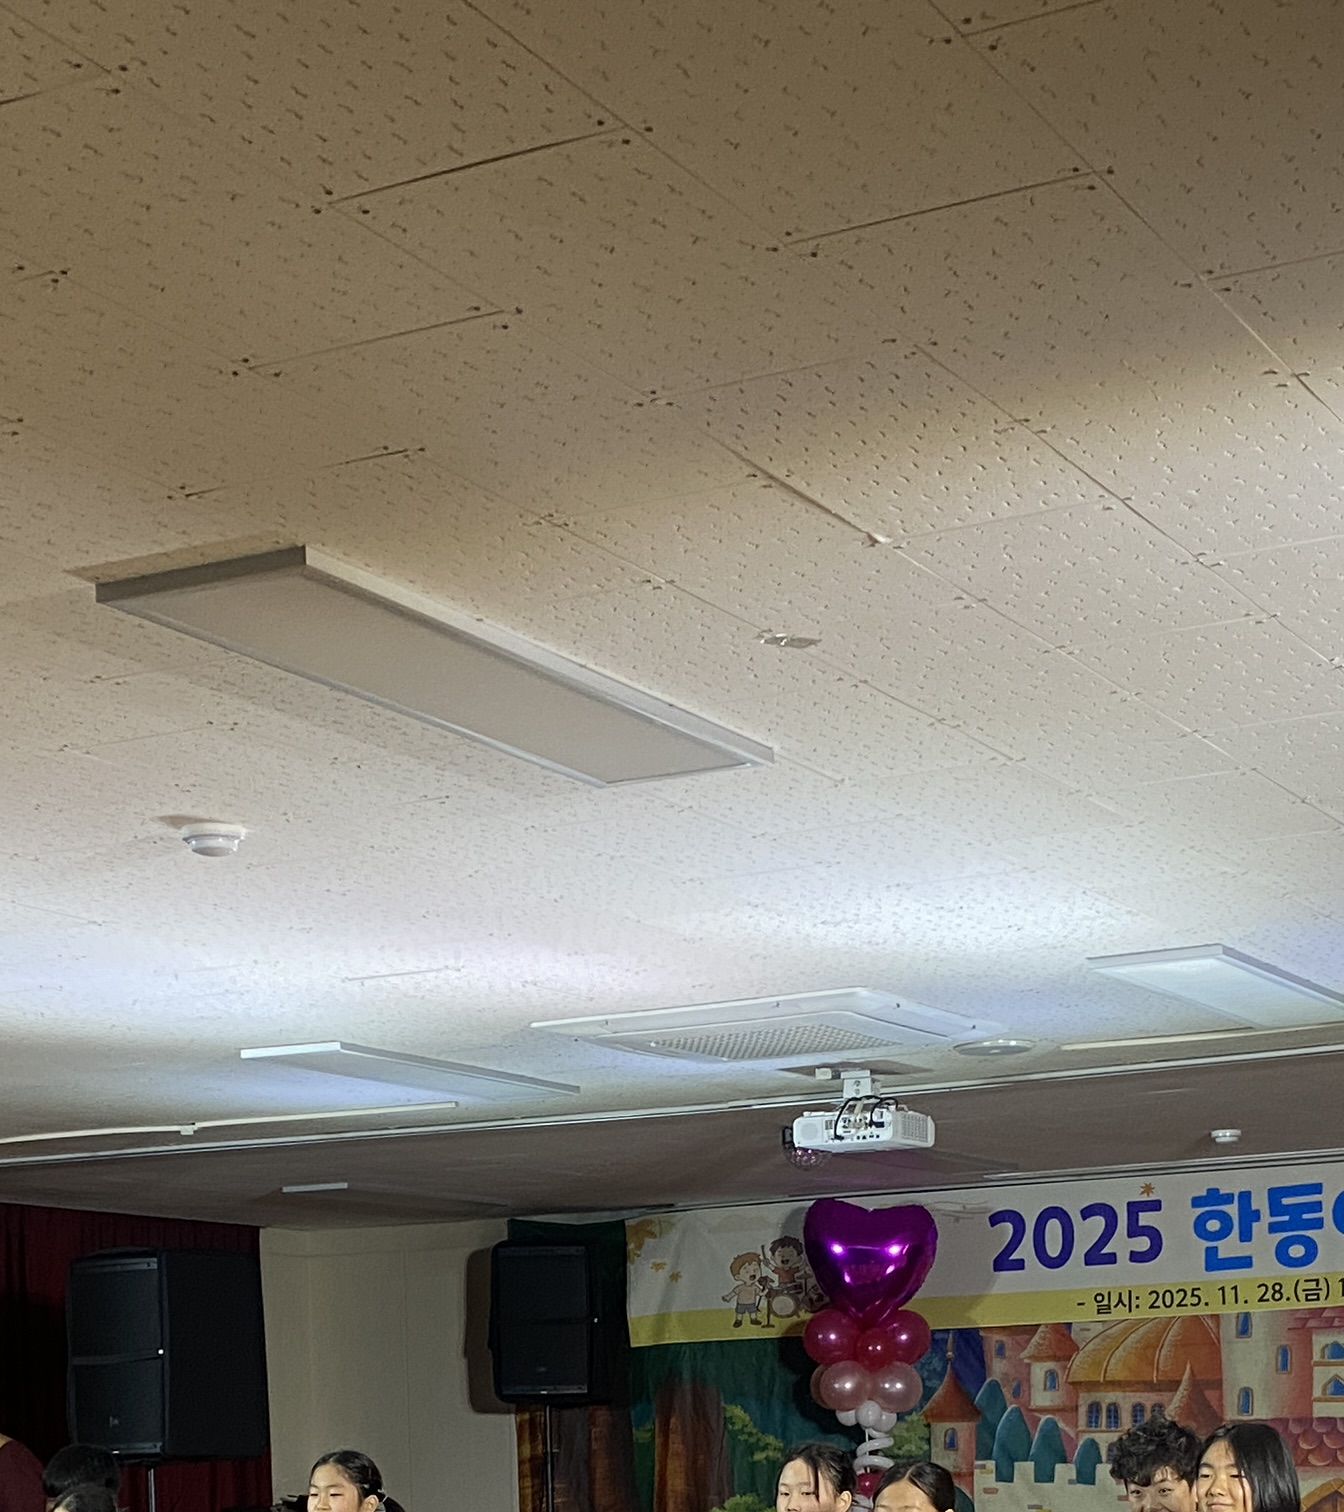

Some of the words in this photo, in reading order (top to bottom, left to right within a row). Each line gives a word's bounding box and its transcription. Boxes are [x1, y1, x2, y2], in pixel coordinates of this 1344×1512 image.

[988, 1199, 1164, 1272] 2025
[1093, 1290, 1140, 1315] 일시:
[1148, 1287, 1209, 1310] 2025.
[1217, 1284, 1249, 1306] 11.
[1256, 1277, 1330, 1303] 28.(금)
